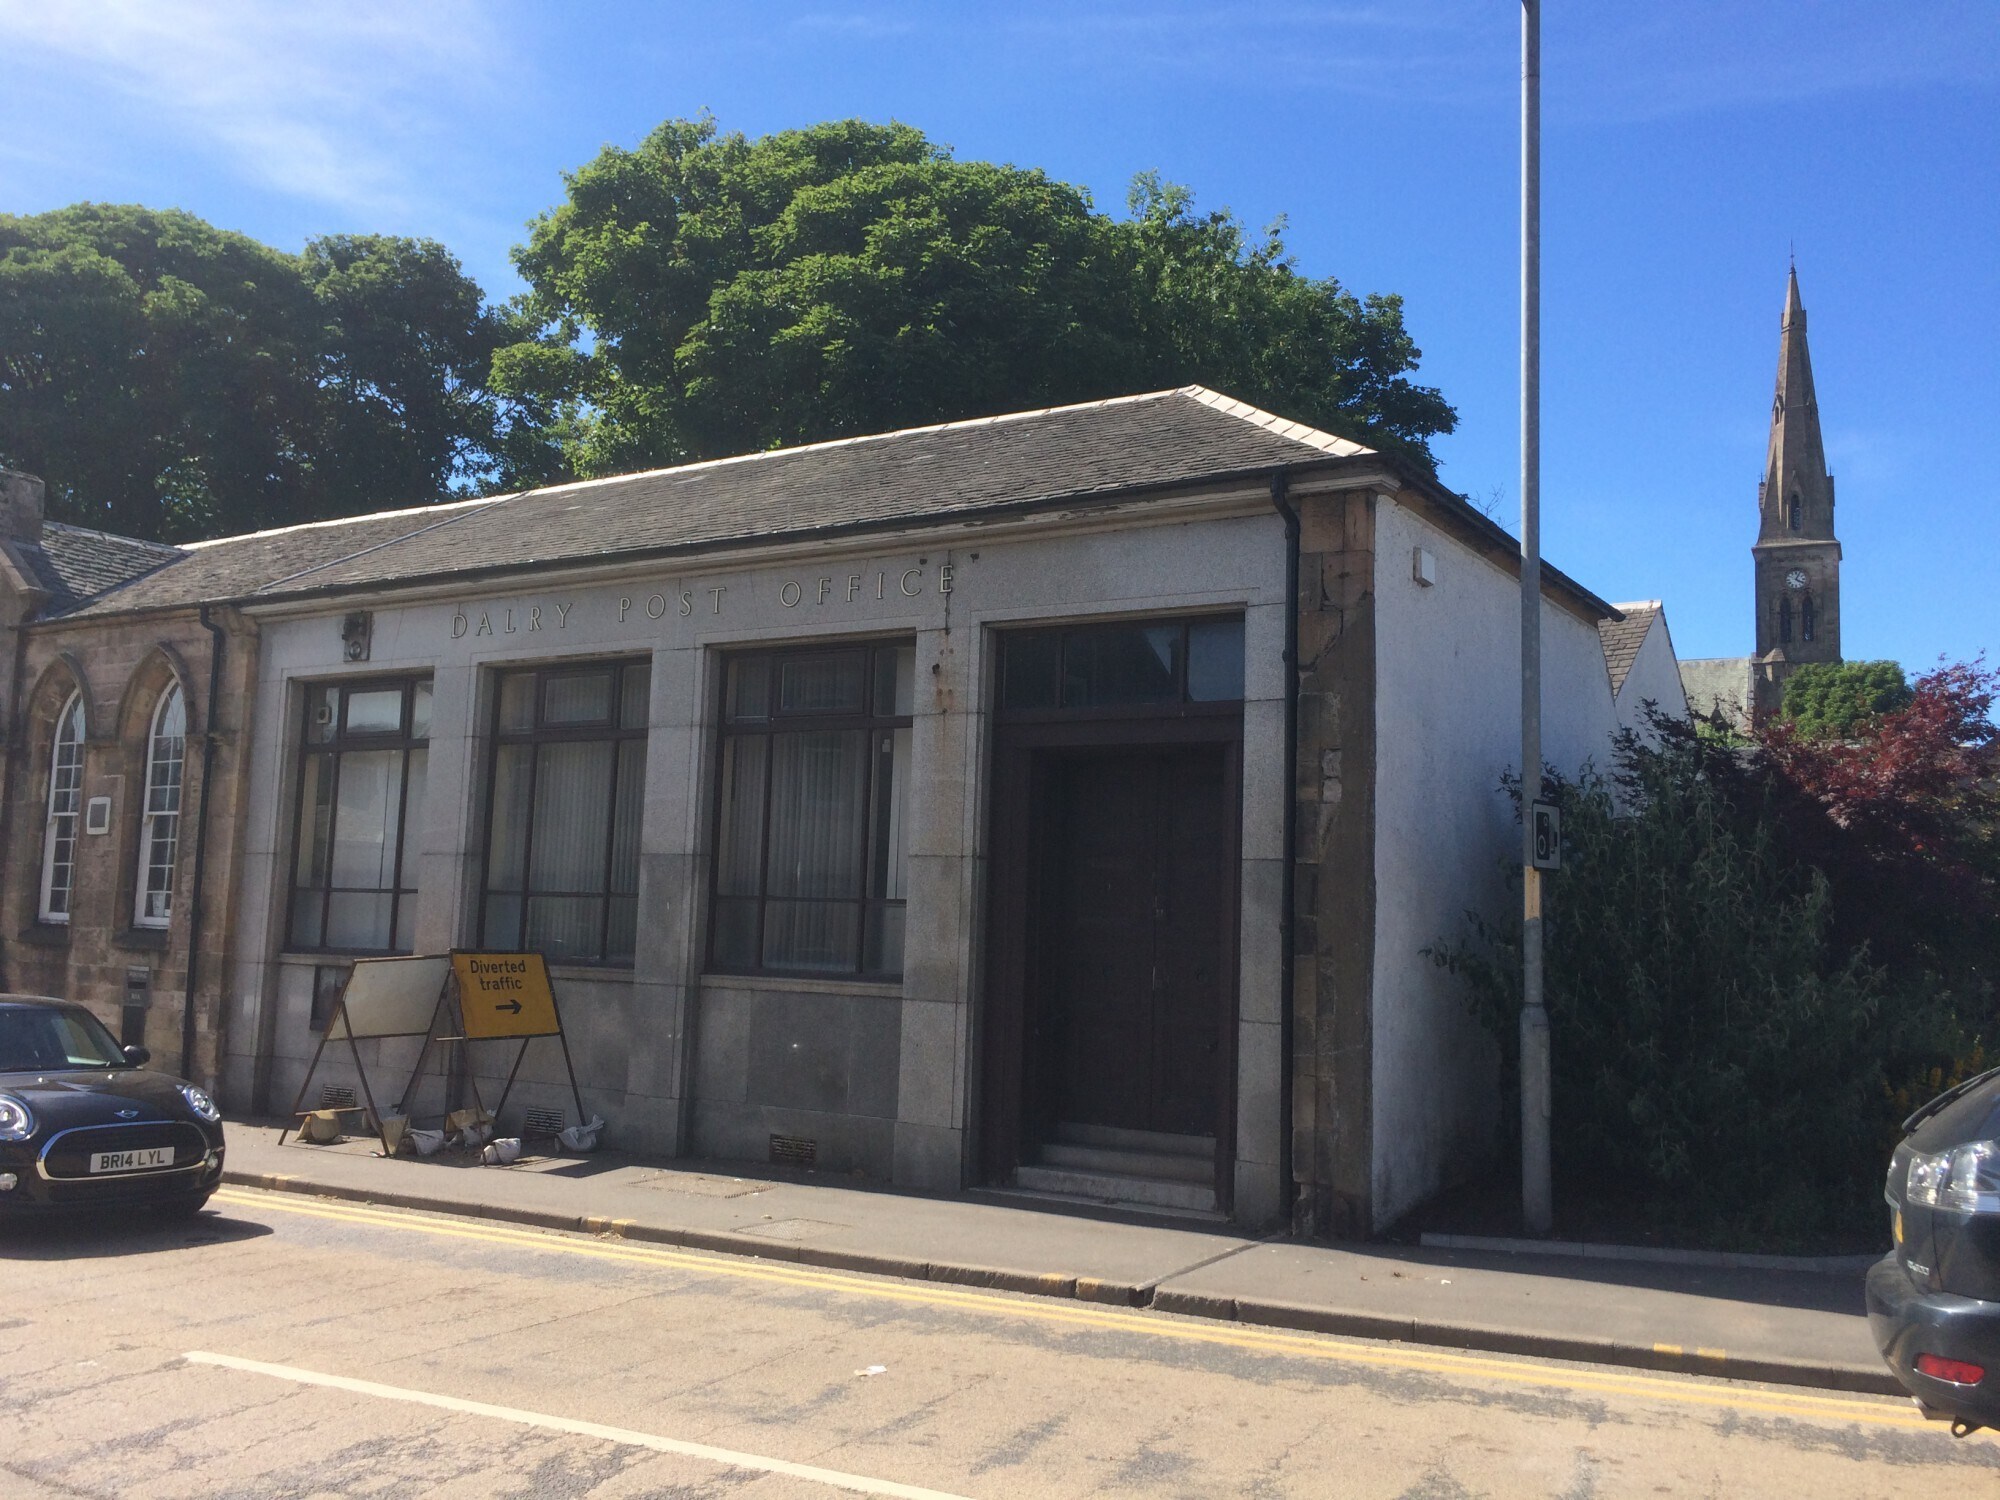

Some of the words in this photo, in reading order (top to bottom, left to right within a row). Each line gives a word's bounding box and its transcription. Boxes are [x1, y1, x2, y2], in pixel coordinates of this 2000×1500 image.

[450, 603, 573, 639] DALRY
[618, 586, 727, 622] POST
[779, 564, 954, 608] OFFICE
[470, 960, 526, 974] Diverted
[480, 976, 523, 991] traffic
[100, 1152, 134, 1170] BR14
[137, 1150, 165, 1166] LYL
